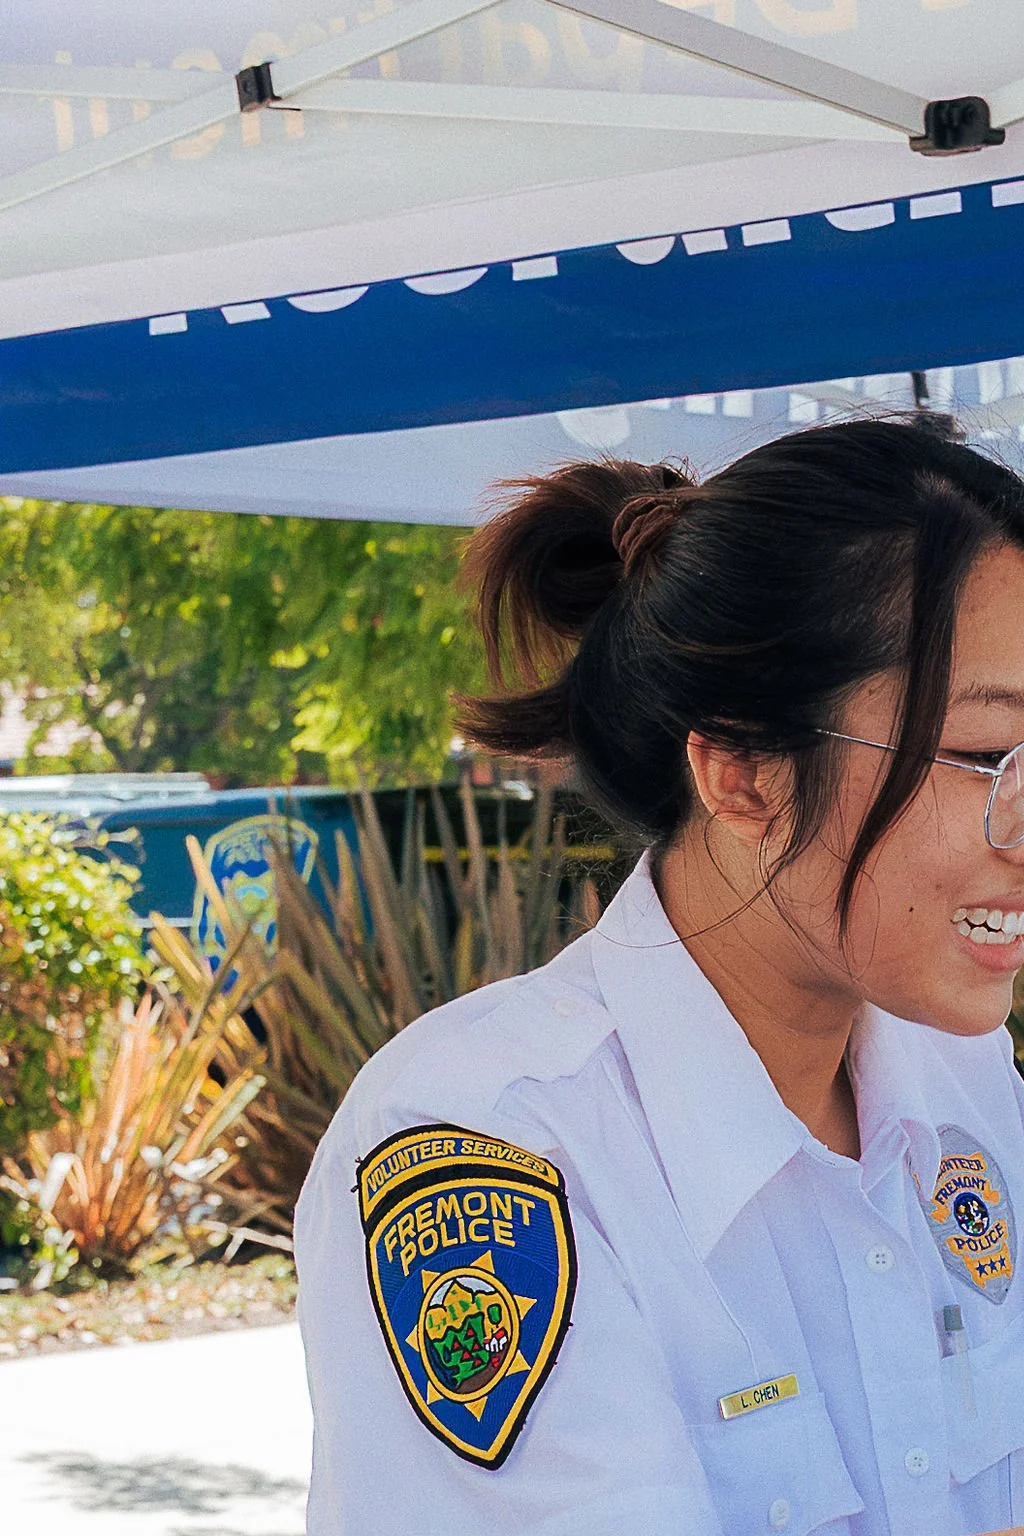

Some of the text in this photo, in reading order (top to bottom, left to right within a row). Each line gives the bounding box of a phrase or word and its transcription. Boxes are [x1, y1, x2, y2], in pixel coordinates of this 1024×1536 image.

[367, 1139, 547, 1192] VOLUNTEER SERVICES
[935, 1176, 986, 1206] FREMONT
[384, 1190, 536, 1264] FREMONT
[400, 1218, 516, 1277] POLICE
[953, 1223, 1006, 1251] POLICE
[741, 1384, 779, 1409] L. CHEN
